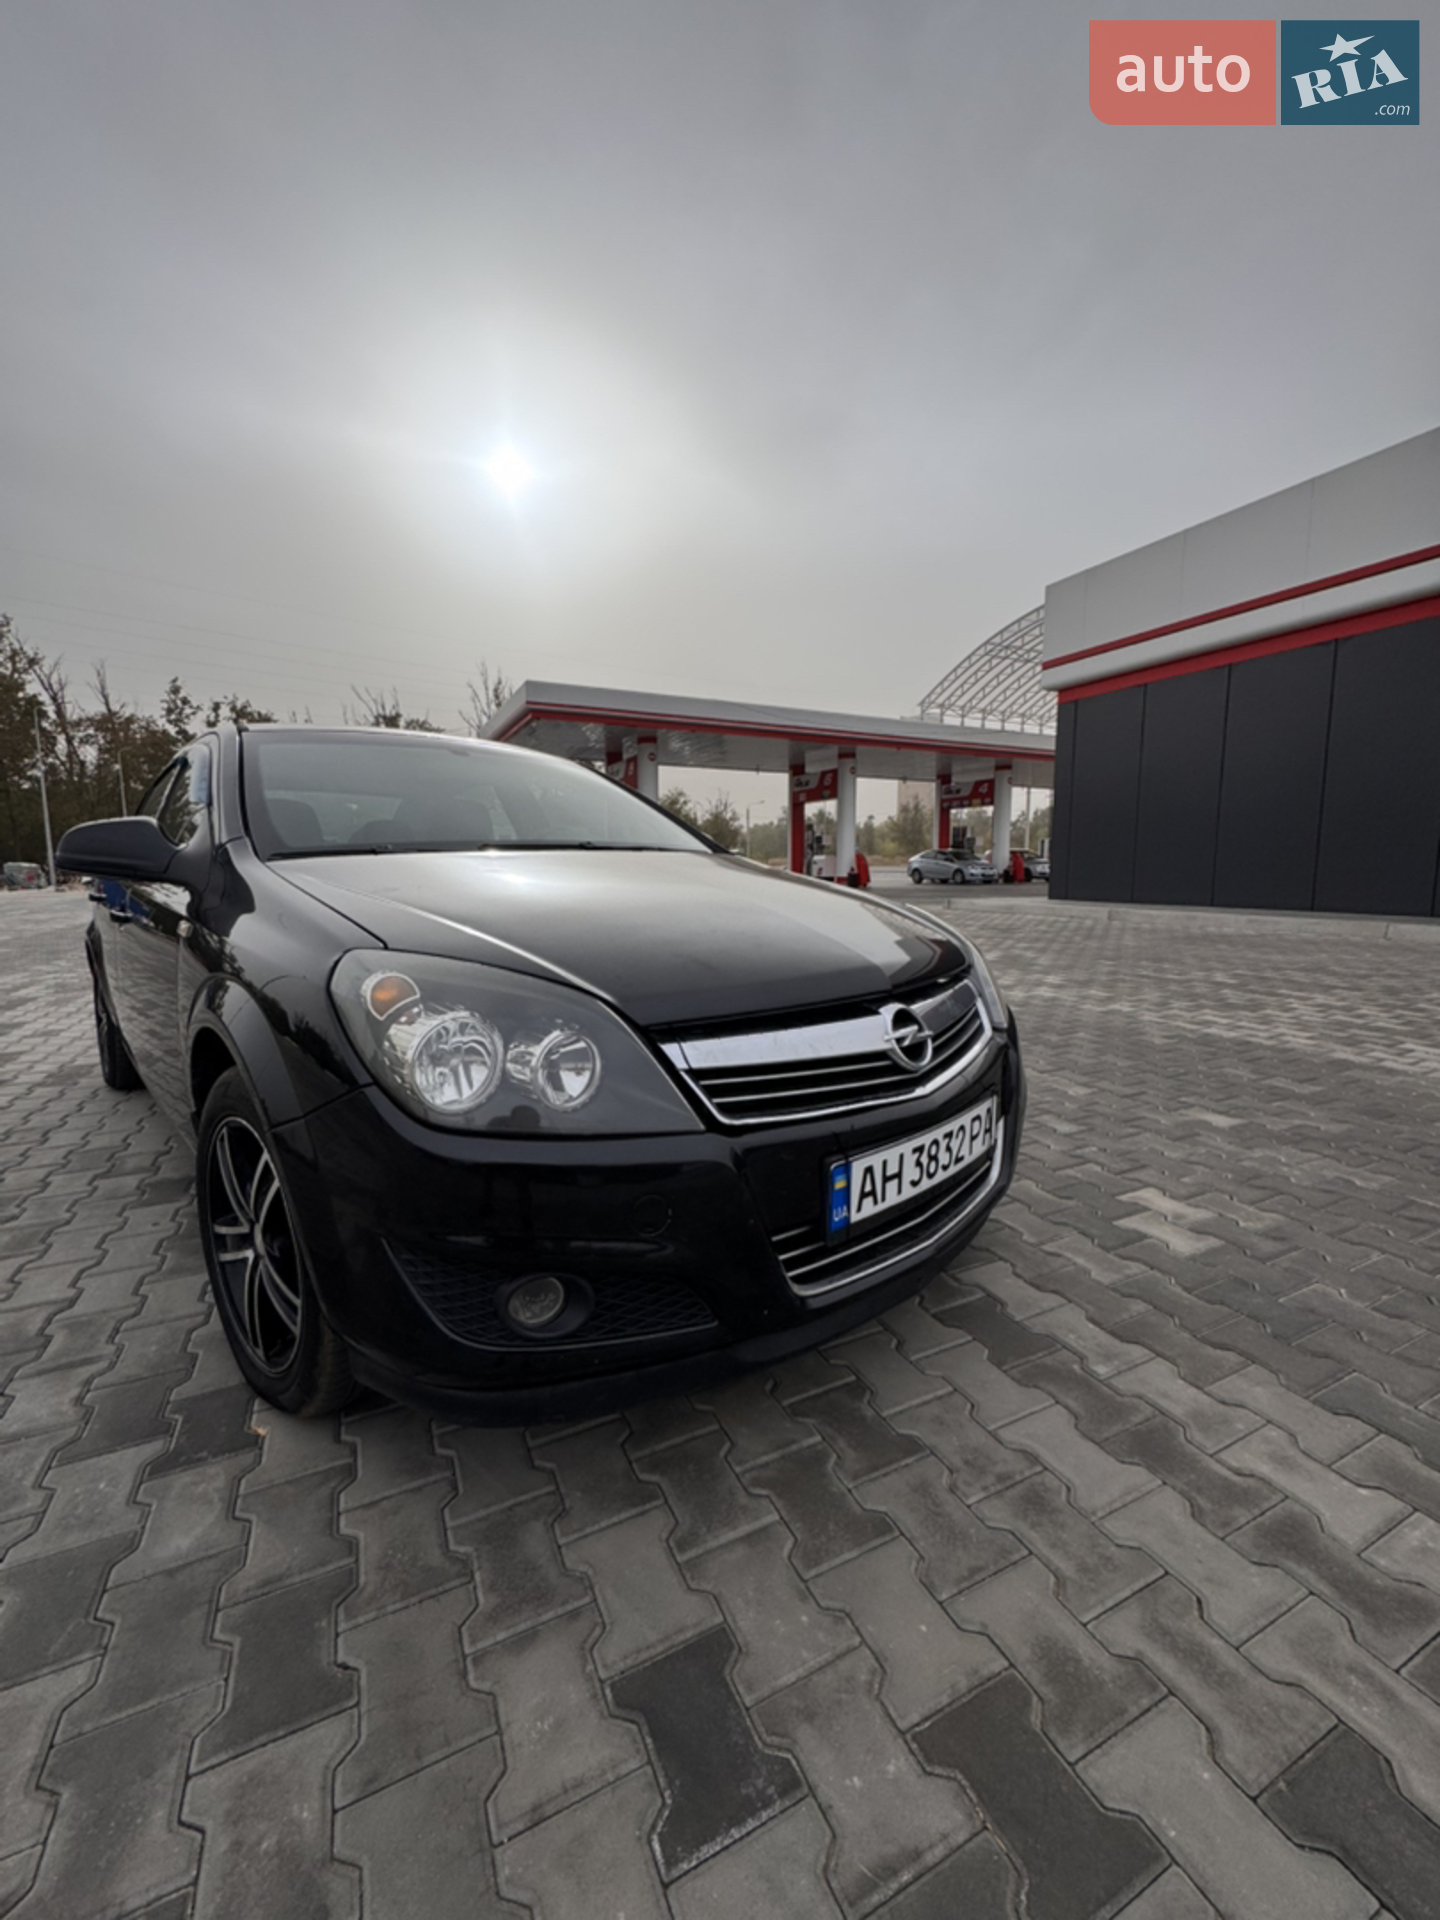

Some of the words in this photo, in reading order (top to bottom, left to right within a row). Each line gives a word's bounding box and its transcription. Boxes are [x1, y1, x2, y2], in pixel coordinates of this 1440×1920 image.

[856, 1152, 904, 1214] AH
[909, 1124, 966, 1188] 3832
[969, 1106, 993, 1156] PA
[833, 1204, 849, 1222] UA
